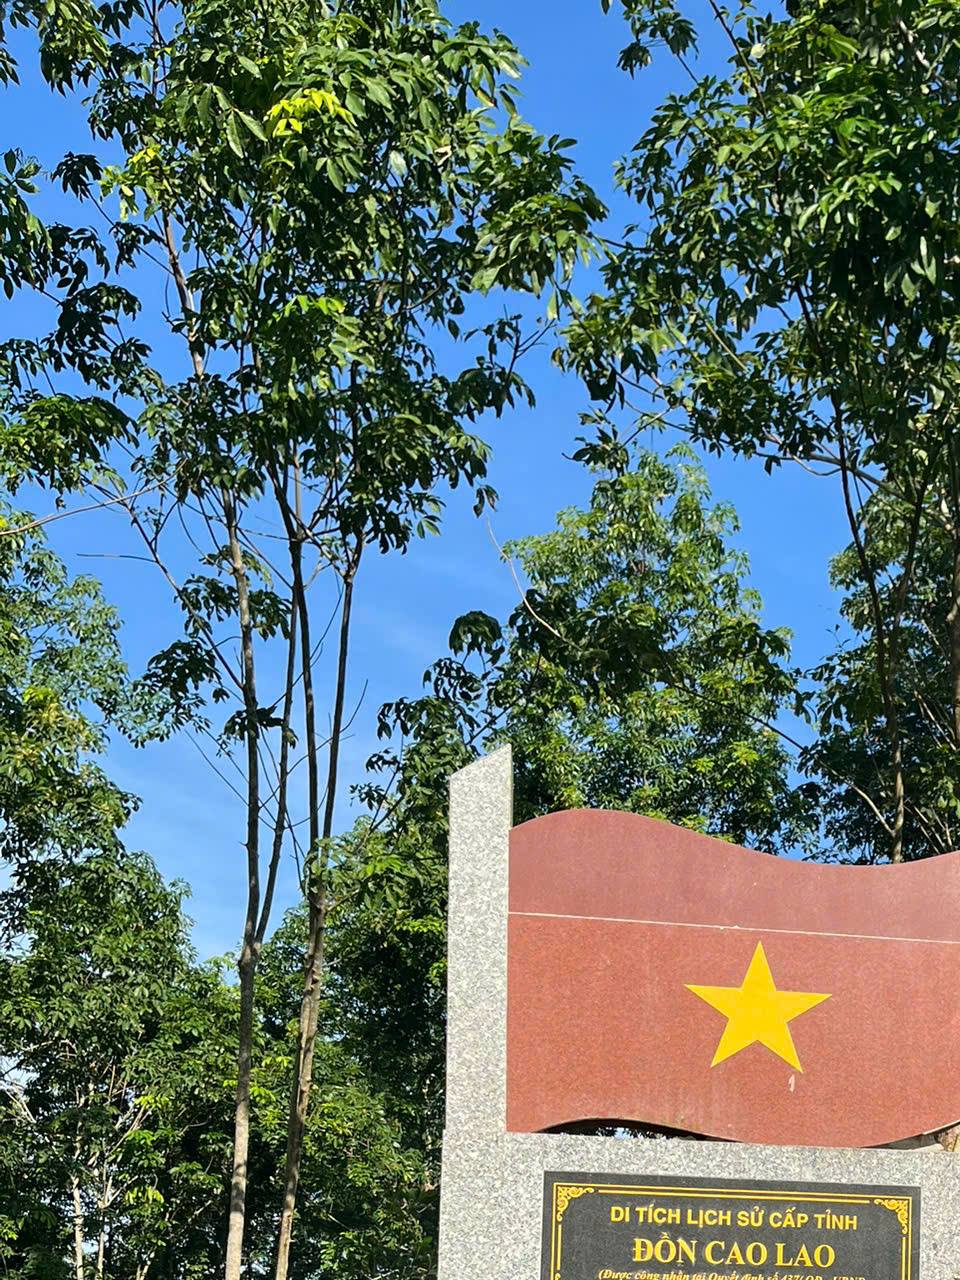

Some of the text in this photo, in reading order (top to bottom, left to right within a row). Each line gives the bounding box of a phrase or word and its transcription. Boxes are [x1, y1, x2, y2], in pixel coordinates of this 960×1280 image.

[610, 1204, 857, 1231] DI TÍCH LỊCH SỬ CẤP TỈNH
[633, 1232, 835, 1267] ĐỒN CAO LAO
